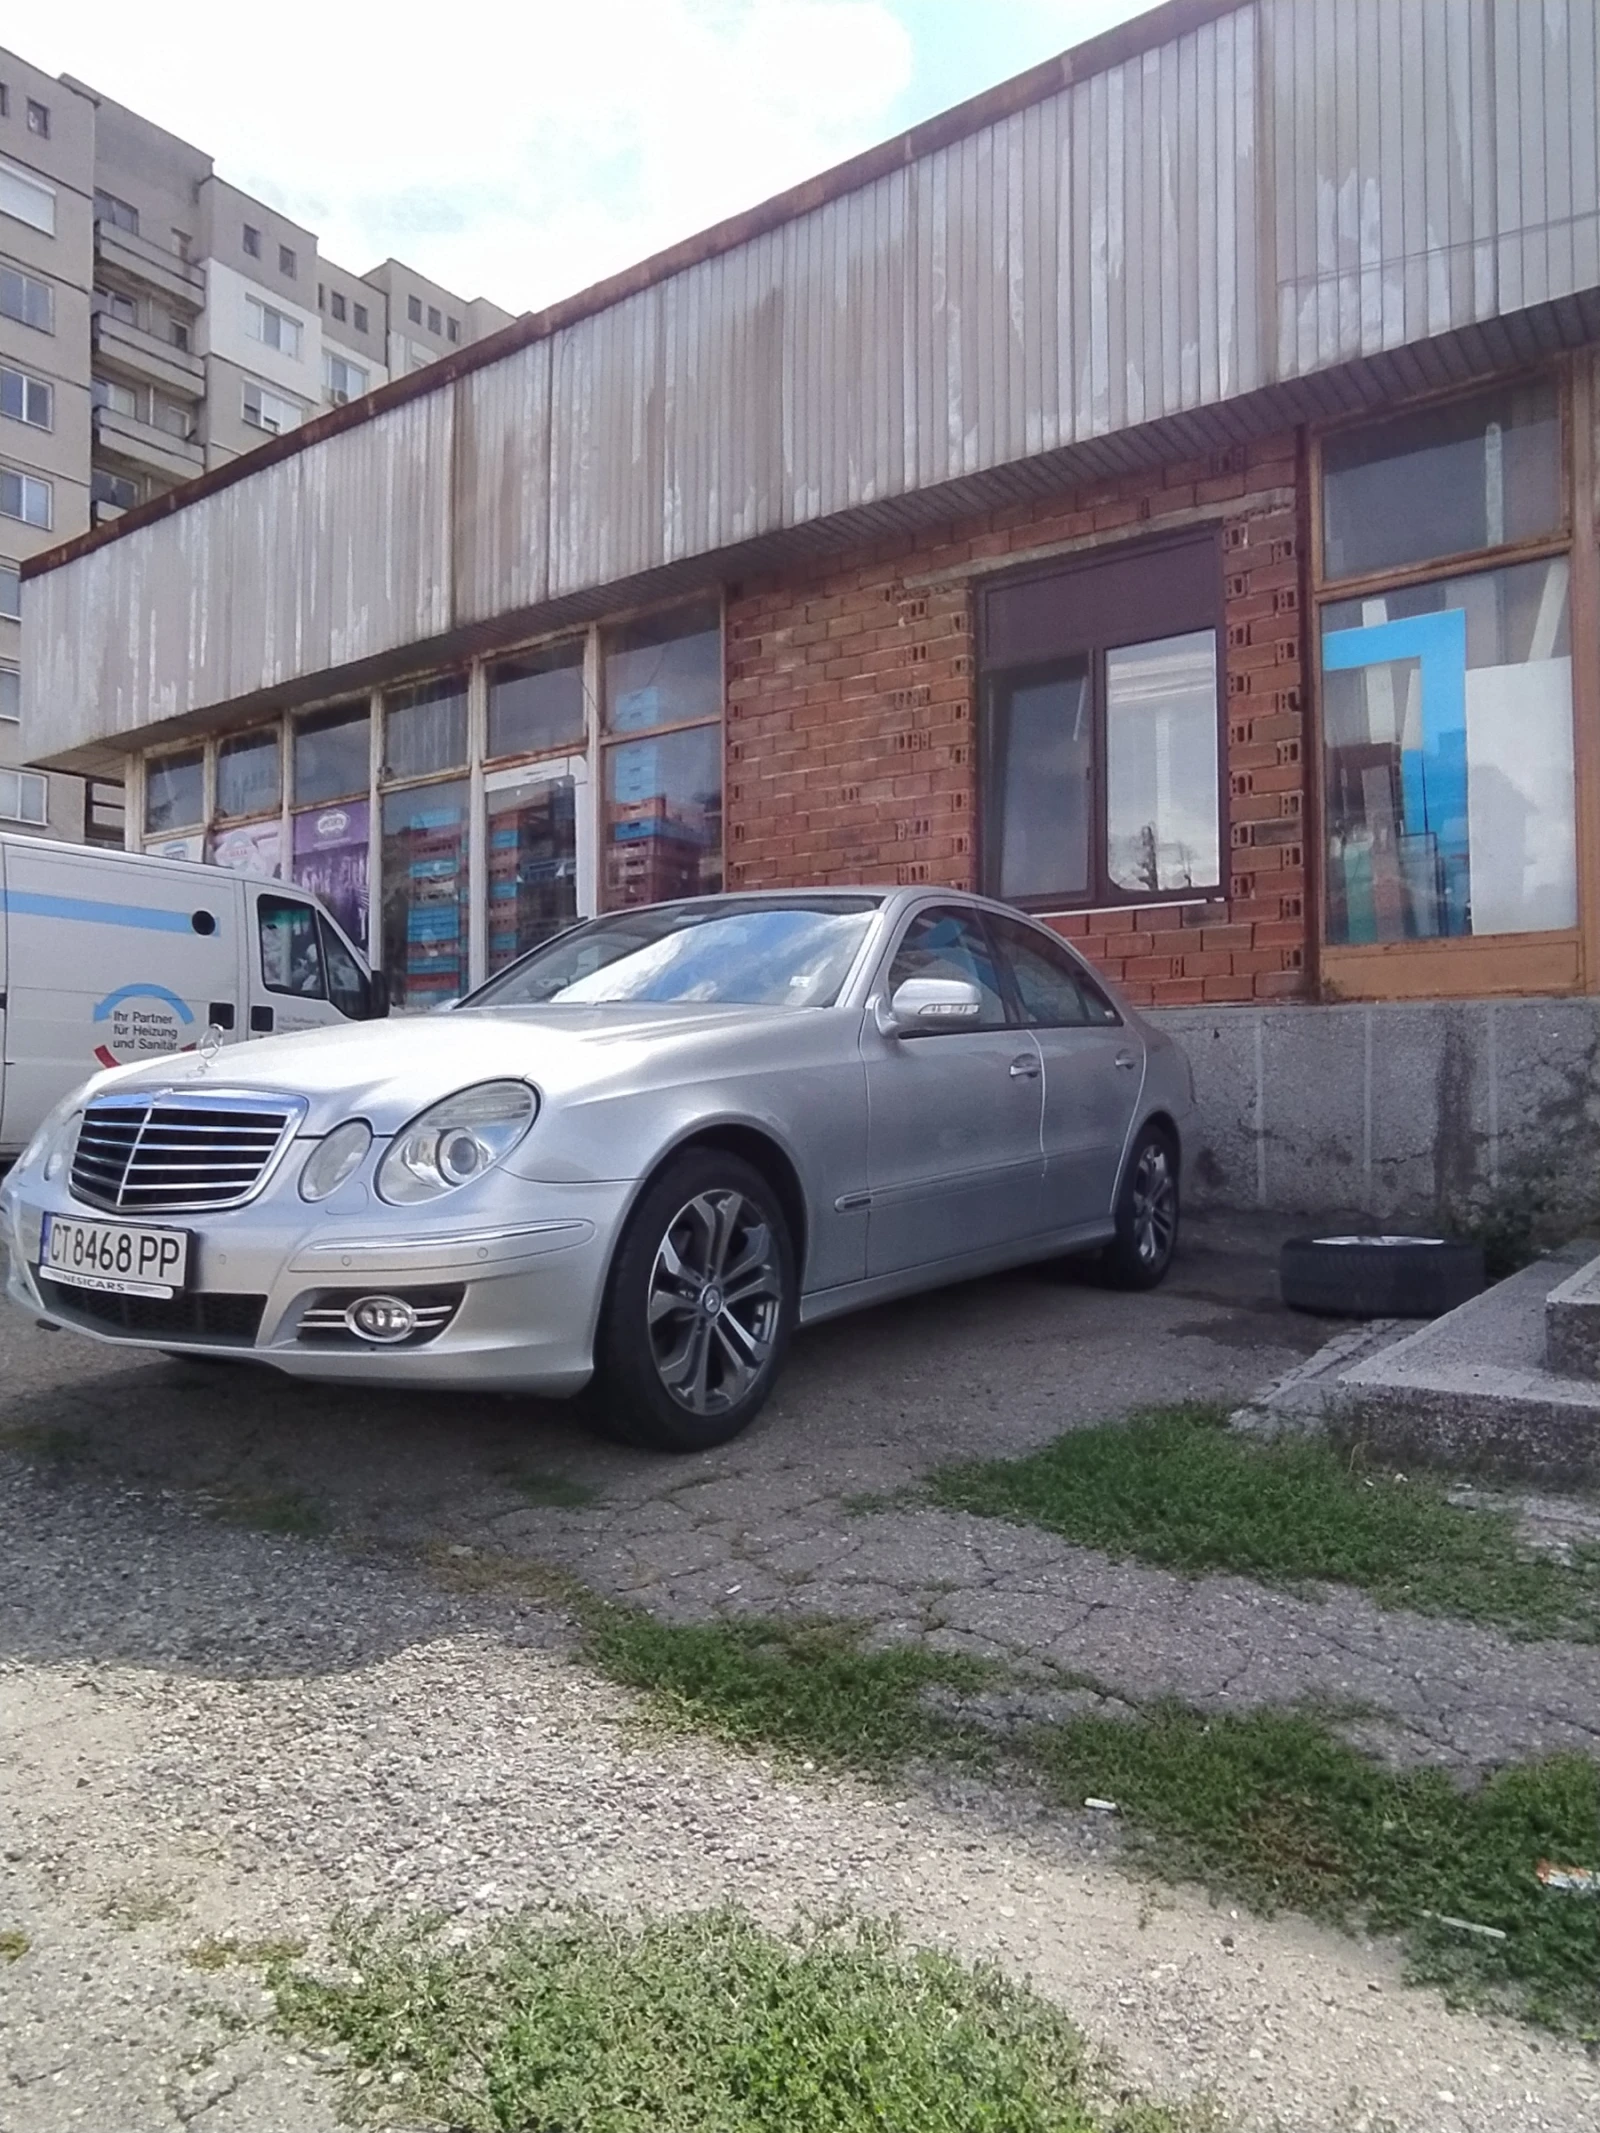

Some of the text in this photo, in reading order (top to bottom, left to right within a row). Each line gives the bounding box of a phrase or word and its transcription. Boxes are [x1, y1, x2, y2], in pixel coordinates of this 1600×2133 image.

[113, 1010, 173, 1024] Ihr Partner
[113, 1023, 178, 1039] für Heizung
[113, 1039, 135, 1049] und
